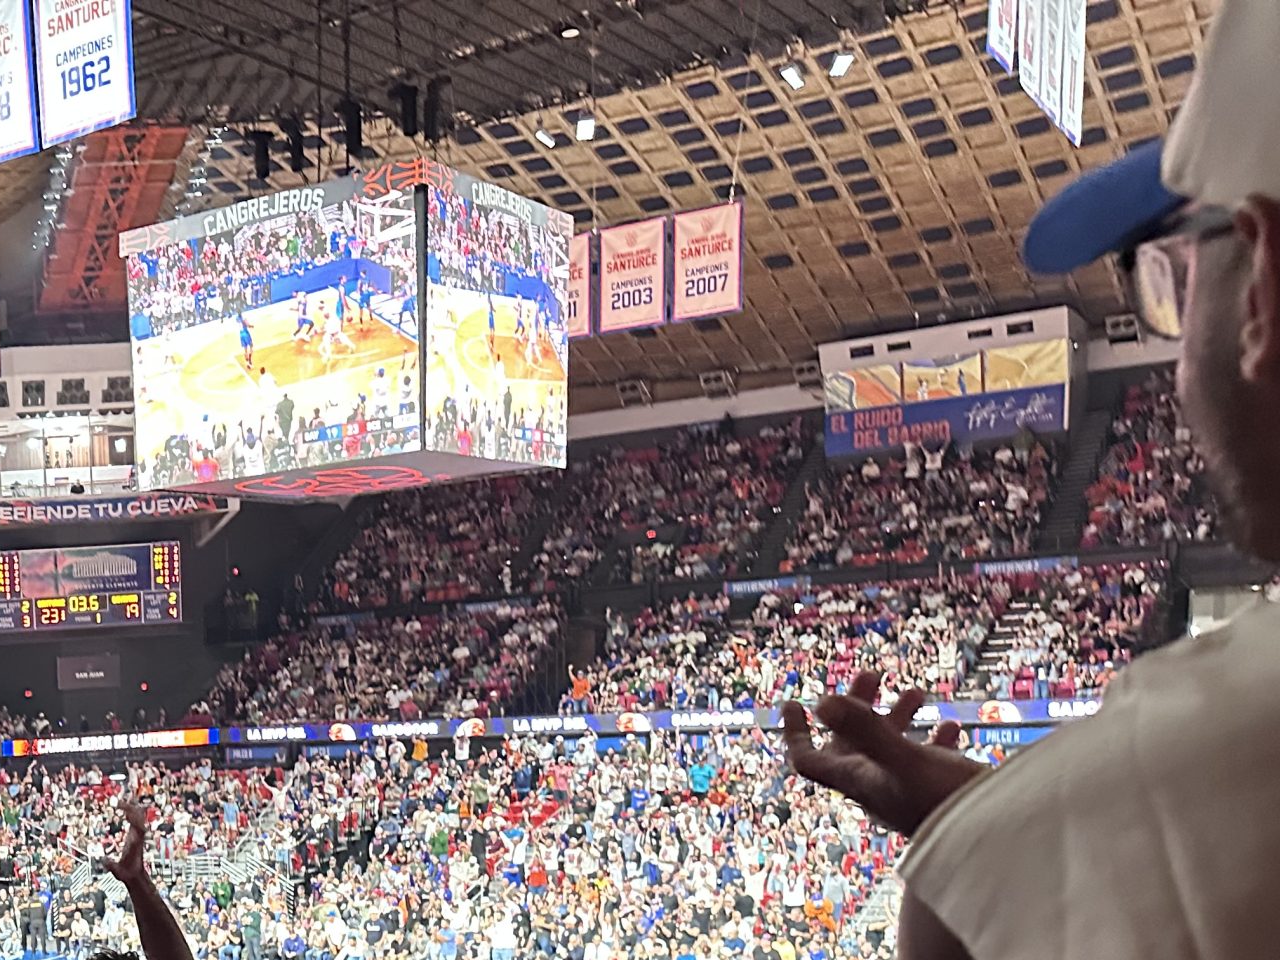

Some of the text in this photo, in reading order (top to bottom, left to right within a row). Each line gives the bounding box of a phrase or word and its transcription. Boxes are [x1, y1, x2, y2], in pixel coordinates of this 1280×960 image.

[56, 35, 113, 67] CAMPEONES
[61, 56, 111, 99] 1962
[472, 182, 532, 220] CANGREJEROS
[204, 188, 325, 237] CANGREJEROS
[680, 239, 734, 260] SANTURCE
[606, 254, 657, 274] SANTURCE
[685, 261, 729, 277] CAMPEONES
[611, 276, 653, 291] CAMPEONES
[685, 273, 729, 297] 2007
[611, 287, 653, 310] 2003
[831, 407, 903, 434] EL RUIDO
[854, 419, 951, 449] DEL BARRIO
[94, 502, 122, 518] TU
[126, 496, 198, 516] CUEVA
[21, 600, 30, 613] 2
[168, 592, 177, 605] 2
[41, 608, 59, 624] 23
[95, 612, 101, 624] 1
[126, 603, 139, 619] 19
[168, 607, 177, 618] 4
[23, 615, 31, 628] 3
[1047, 701, 1099, 718] SABO
[512, 719, 530, 732] LA
[531, 717, 563, 731] MVP
[246, 728, 261, 740] LA
[986, 730, 1012, 743] PALCO
